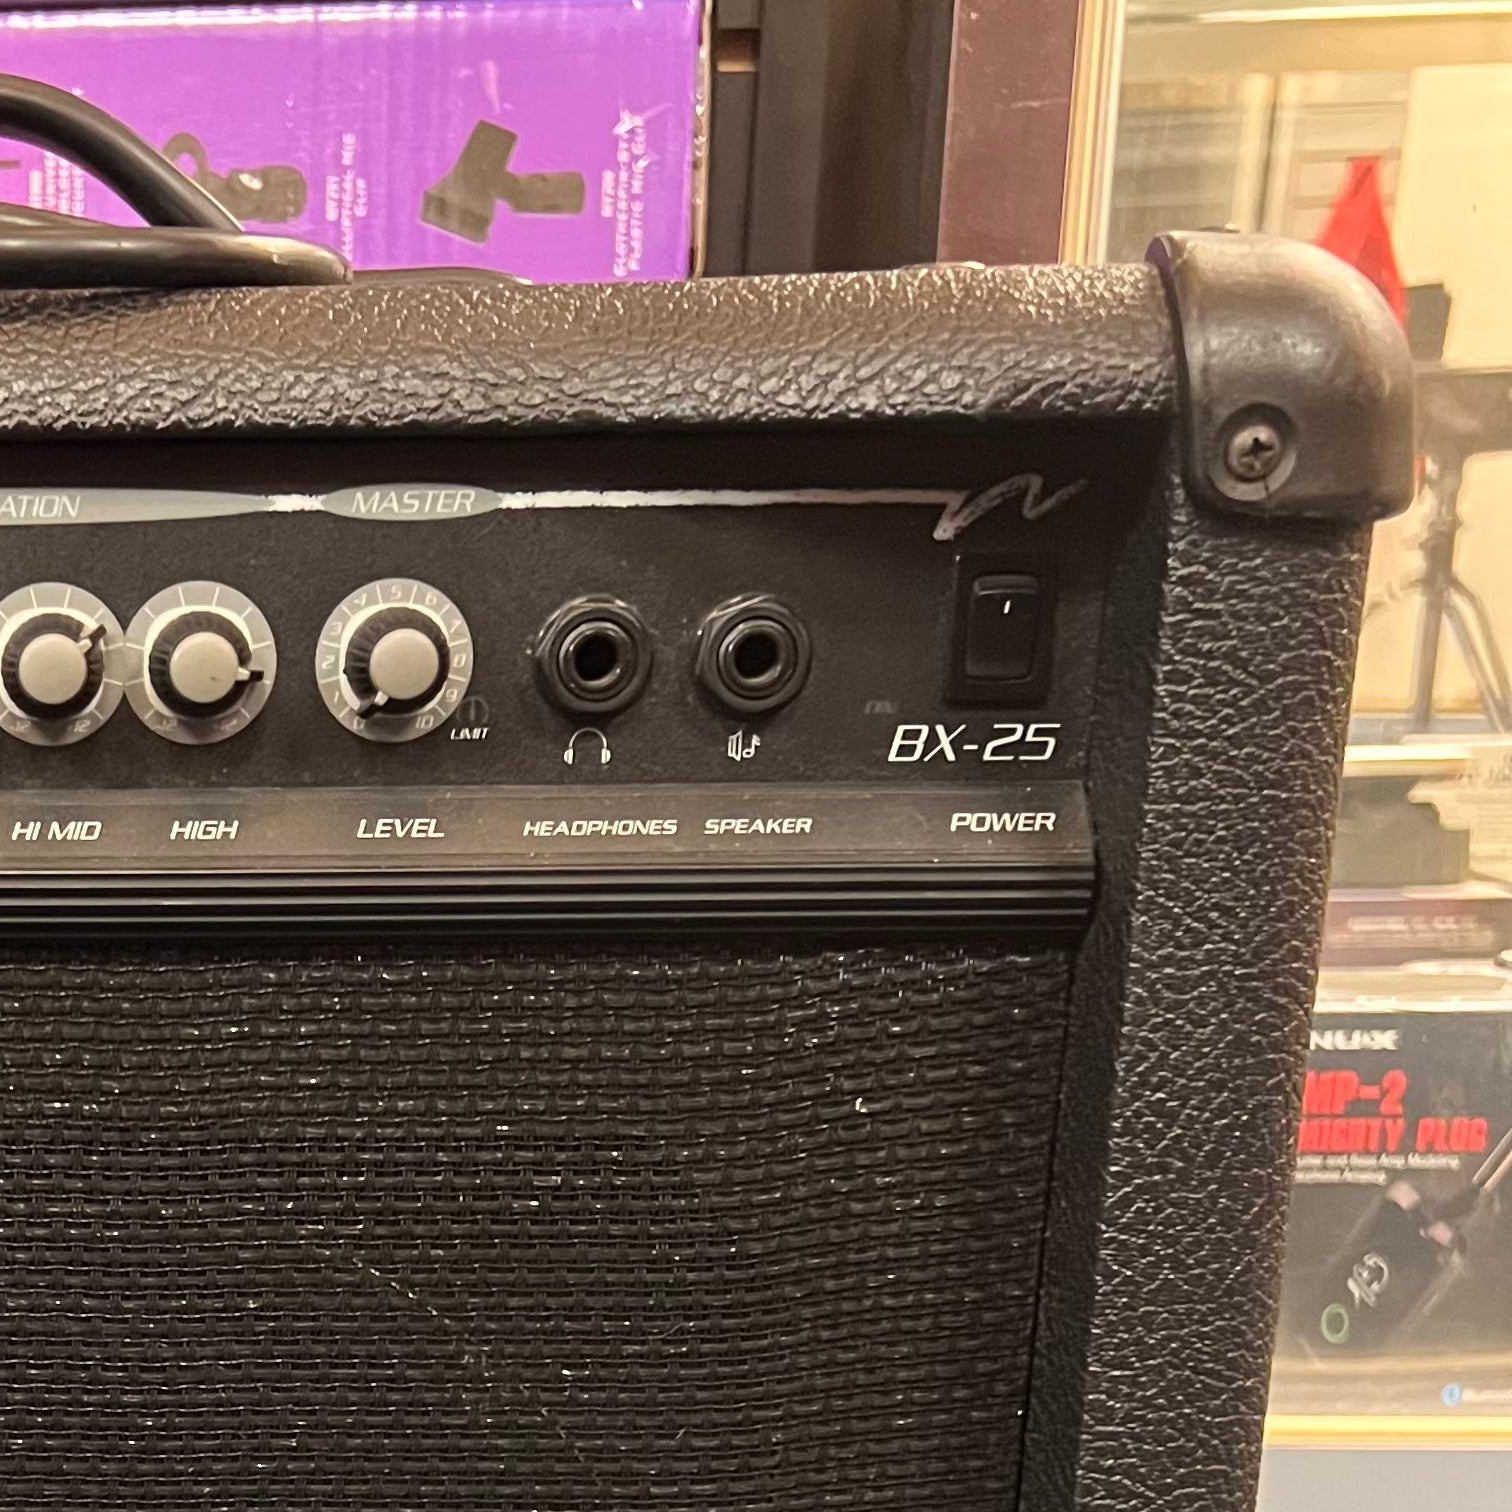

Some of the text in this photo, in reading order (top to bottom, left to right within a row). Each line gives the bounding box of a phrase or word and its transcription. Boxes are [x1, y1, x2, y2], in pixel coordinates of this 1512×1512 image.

[350, 490, 476, 514] MASTER
[888, 723, 1061, 762] BX-25
[11, 820, 103, 840] HI MID
[169, 819, 239, 839] HIGH
[356, 818, 445, 839] LEVEL
[522, 818, 678, 836] HEADPHONES
[703, 817, 813, 835] SPEAKER
[949, 811, 1057, 832] POWER
[1309, 1029, 1400, 1051] NUX
[1415, 1116, 1488, 1153] PLUG
